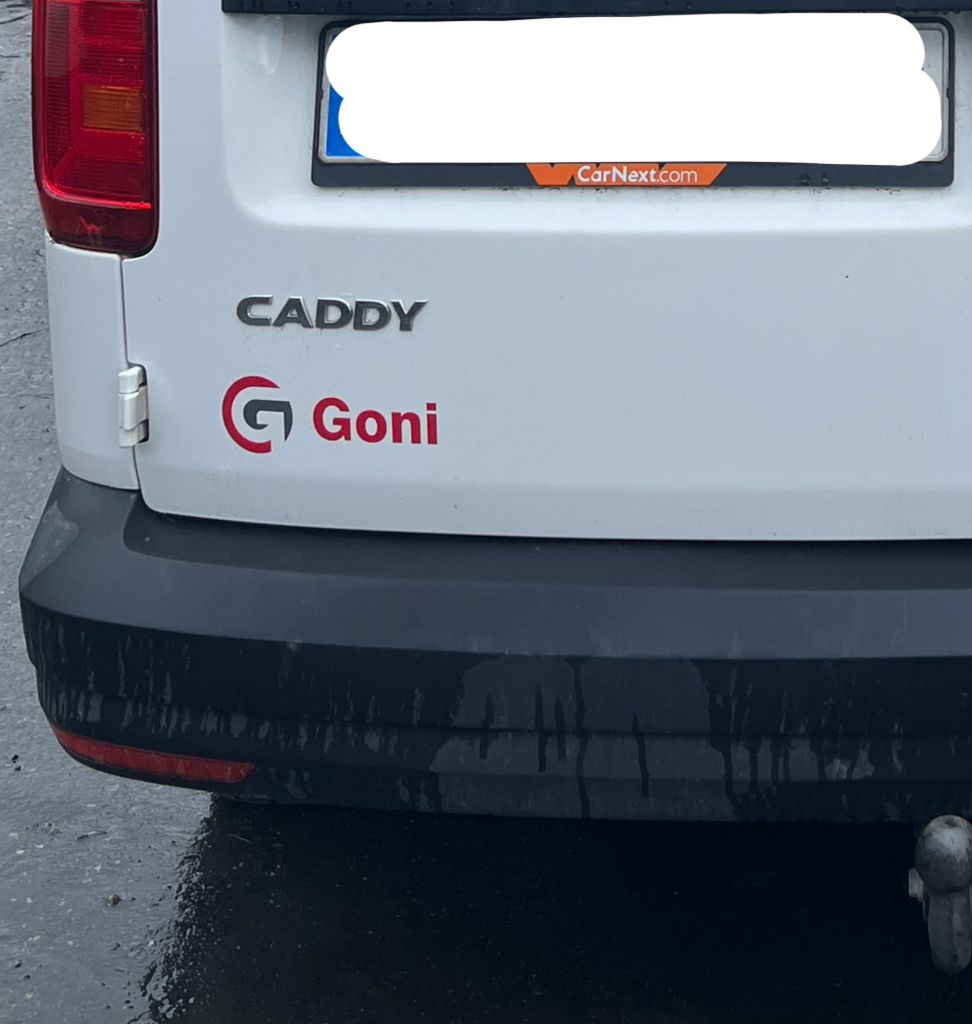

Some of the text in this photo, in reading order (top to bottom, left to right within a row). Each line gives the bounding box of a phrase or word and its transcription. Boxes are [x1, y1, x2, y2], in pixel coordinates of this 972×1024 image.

[577, 165, 698, 183] CarNext.com
[236, 294, 429, 332] CADDY
[312, 397, 438, 445] Goni
